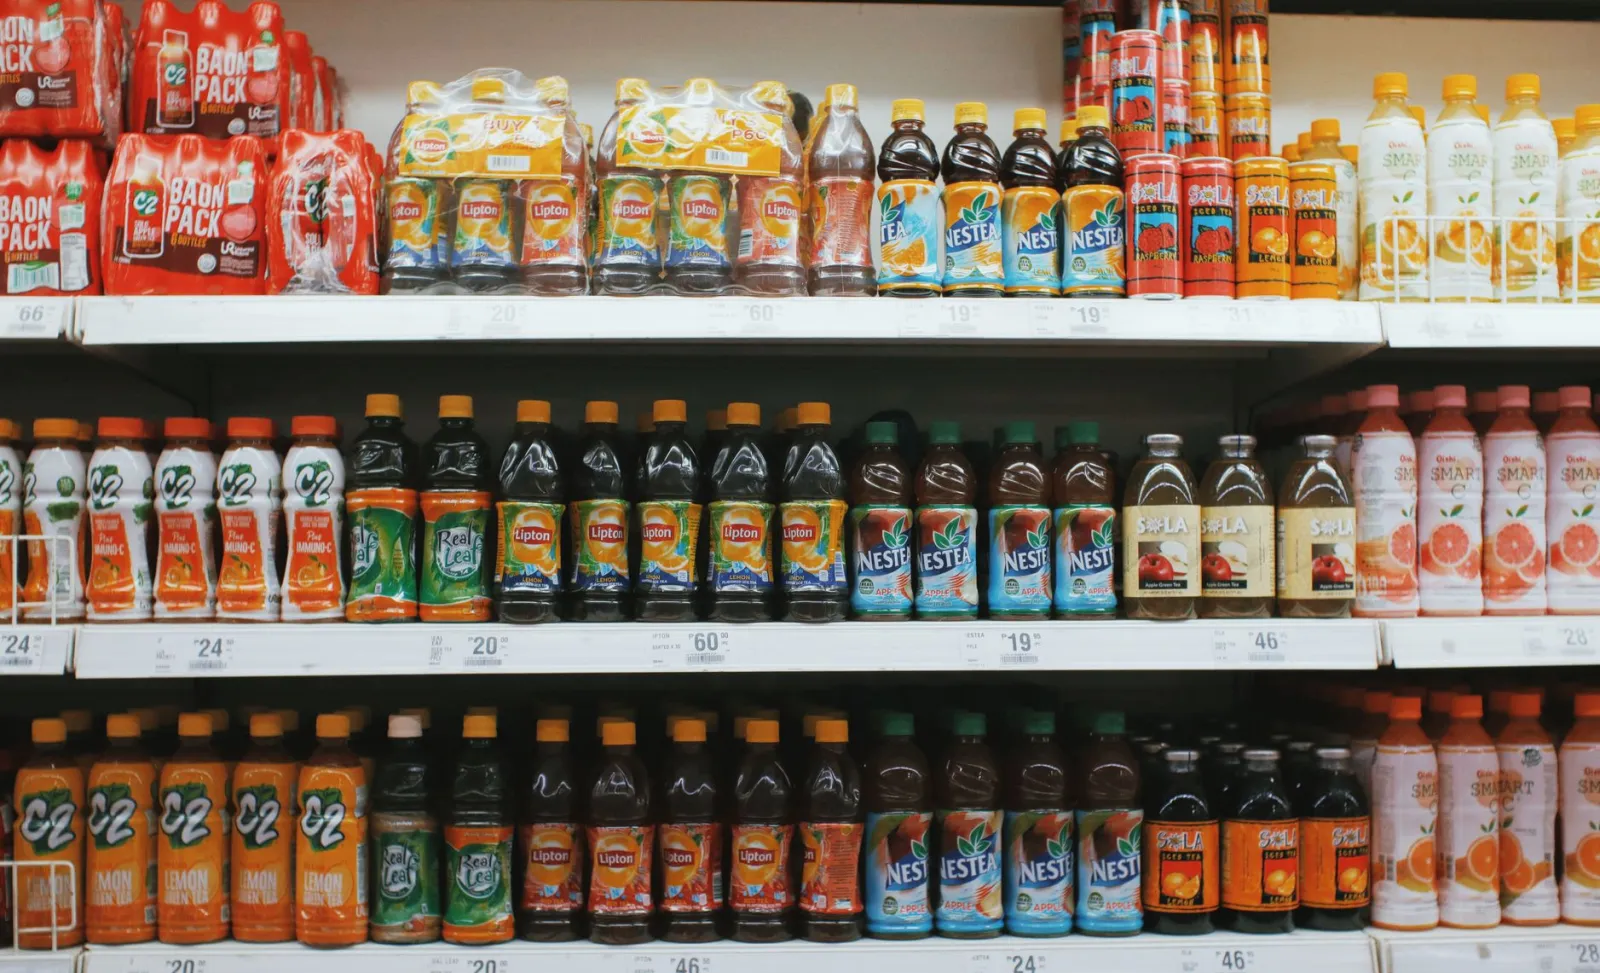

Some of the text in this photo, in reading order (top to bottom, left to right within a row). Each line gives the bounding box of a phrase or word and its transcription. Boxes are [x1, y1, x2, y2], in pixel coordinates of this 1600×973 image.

[196, 48, 248, 75] BAON
[1111, 56, 1156, 77] SOLA
[165, 64, 187, 85] C2
[194, 75, 247, 103] PACK
[484, 119, 525, 132] BUY
[1112, 124, 1153, 134] RASPBERRY
[416, 140, 446, 152] Lipton
[170, 177, 225, 209] BAON
[1131, 182, 1179, 205] SOLA
[1188, 185, 1233, 207] SOLA
[1246, 185, 1290, 207] SOLA
[1293, 189, 1338, 210] SOLA
[0, 195, 52, 223] BAON
[133, 190, 159, 215] C2
[463, 204, 498, 217] Lipton
[685, 203, 718, 218] Lipton
[767, 203, 798, 218] Lipton
[1136, 204, 1177, 213] ICED TEA
[534, 205, 569, 218] Lipton
[1193, 207, 1232, 216] ICED TEA
[1250, 207, 1273, 216] ICED
[1297, 211, 1321, 219] ICED
[165, 205, 222, 237] PACK
[0, 221, 51, 251] PACK
[177, 235, 206, 248] BOTTLES
[945, 222, 1000, 247] NESTEA
[1072, 227, 1124, 250] NESTEA
[1135, 252, 1178, 262] RASPBERRY
[1258, 254, 1285, 263] LEMON
[1304, 256, 1332, 266] LEMON
[1436, 455, 1457, 464] Oishi
[1503, 455, 1523, 464] Oishi
[1566, 455, 1588, 464] Oishi
[91, 470, 124, 507] C2
[160, 470, 196, 506] C2
[221, 467, 257, 504] C2
[295, 465, 334, 504] C2
[1451, 483, 1466, 500] C
[1517, 483, 1532, 500] C
[1583, 483, 1597, 500] C
[591, 526, 623, 542] Lipton
[643, 526, 672, 542] Lipton
[724, 527, 758, 541] Lipton
[783, 527, 813, 541] Lipton
[1137, 516, 1189, 535] SOLA
[1202, 516, 1249, 535] SOLA
[1309, 518, 1354, 537] SOLA
[306, 530, 322, 540] Plus
[437, 521, 472, 551] Real
[515, 528, 551, 545] Lipton
[296, 541, 332, 554] IMMUNO-C
[444, 533, 484, 568] Leaf
[1004, 547, 1048, 572] NESTE
[925, 588, 950, 597] APPLE
[1088, 587, 1109, 595] APPLE
[21, 798, 76, 850] C2
[89, 791, 137, 845] C2
[161, 791, 212, 845] C2
[236, 792, 281, 846] C2
[301, 795, 345, 848] C2
[1156, 831, 1205, 851] SOLA
[533, 850, 568, 863] Lipton
[600, 853, 634, 866] Lipton
[740, 851, 773, 864] Lipton
[1020, 855, 1073, 884] NESTE
[164, 868, 209, 890] LEMON
[239, 868, 277, 890] LEMON
[303, 870, 343, 892] LEMON
[900, 904, 926, 913] APPLE
[945, 901, 972, 910] APPLE
[1105, 902, 1132, 910] APPLE
[1166, 897, 1194, 906] LEMON
[1269, 895, 1293, 905] LEMON
